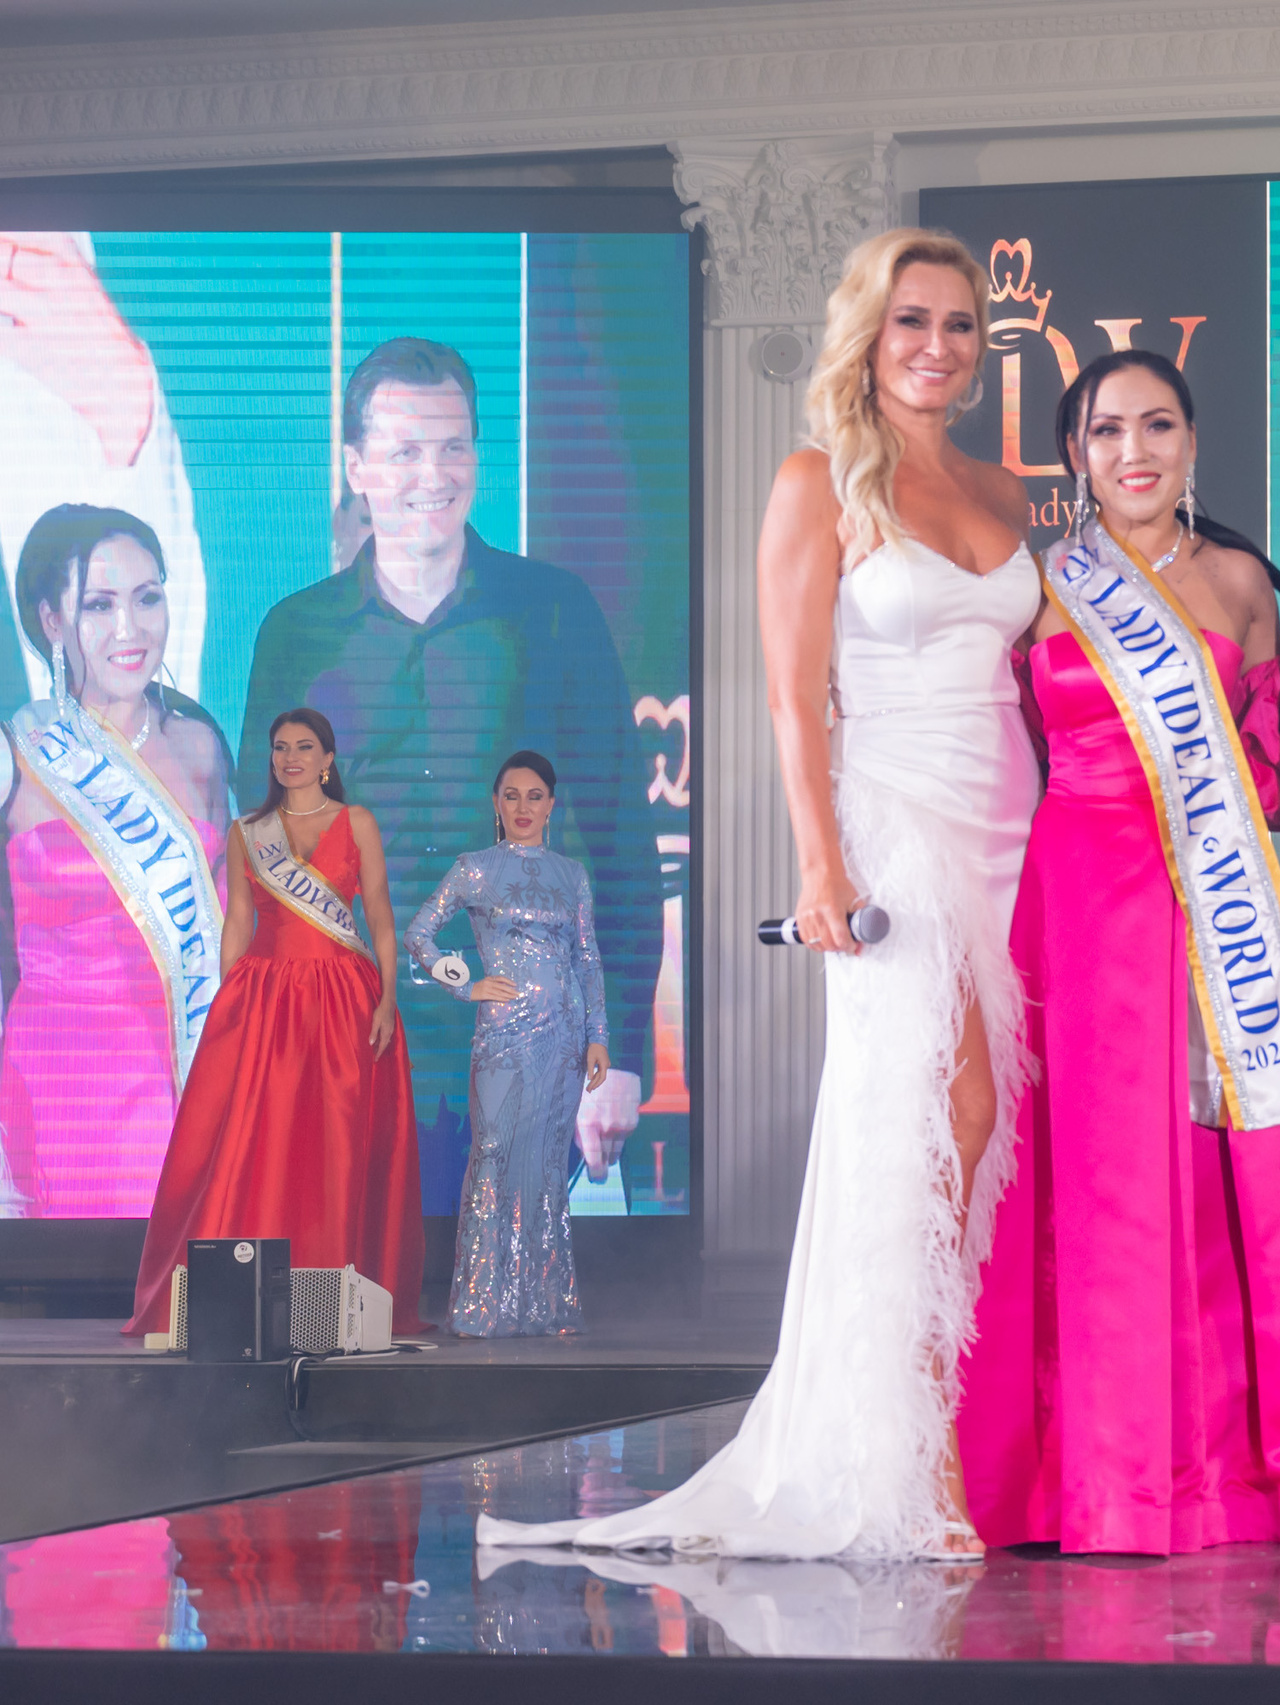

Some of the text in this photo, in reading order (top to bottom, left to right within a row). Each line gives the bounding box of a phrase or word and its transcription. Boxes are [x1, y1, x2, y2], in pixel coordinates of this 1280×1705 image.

[1028, 487, 1079, 539] ady
[268, 857, 326, 904] LADY
[1087, 574, 1188, 678] LADY
[1153, 680, 1227, 836] IDEAL
[1197, 848, 1280, 1035] WORLD
[72, 755, 212, 1040] LADY IDEAL
